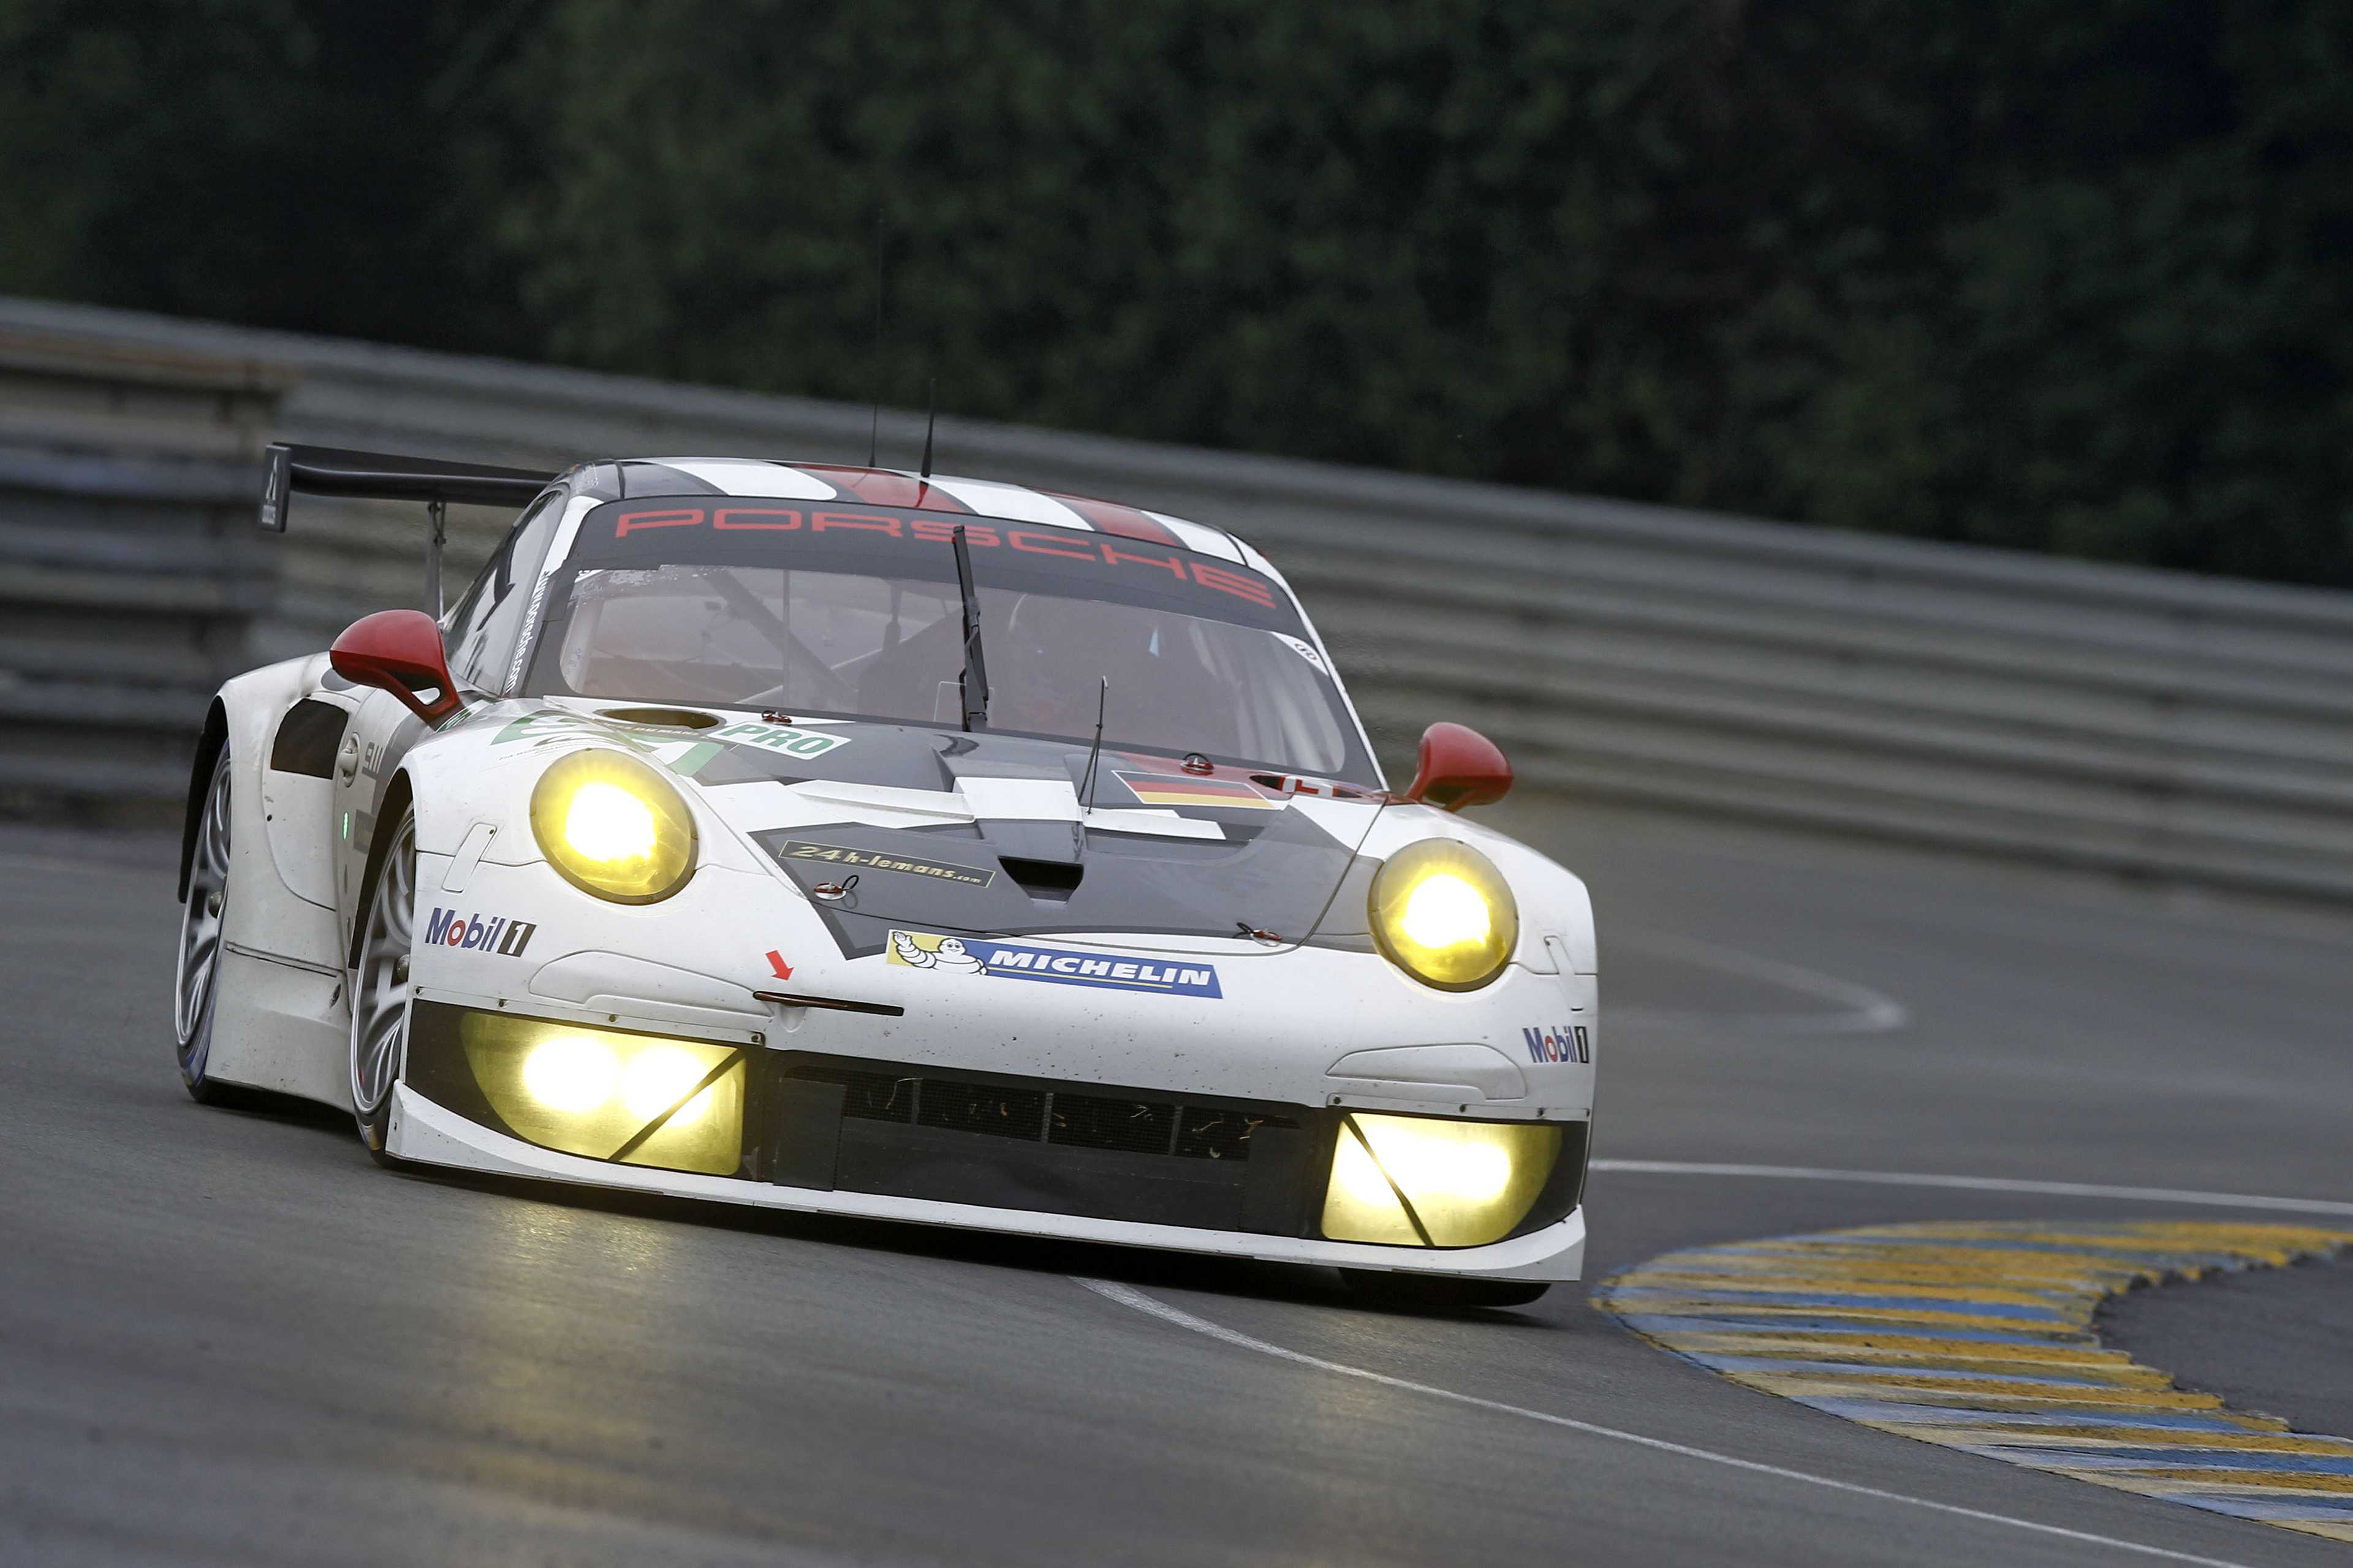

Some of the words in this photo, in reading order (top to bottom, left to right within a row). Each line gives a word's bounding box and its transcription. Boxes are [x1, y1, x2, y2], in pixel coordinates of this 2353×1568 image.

[615, 507, 1276, 608] PORSCHE
[720, 724, 835, 754] PRO
[425, 907, 506, 952] Mobil
[501, 922, 533, 956] 1
[988, 950, 1211, 986] MICHELIN
[1522, 1026, 1578, 1063] Mobil
